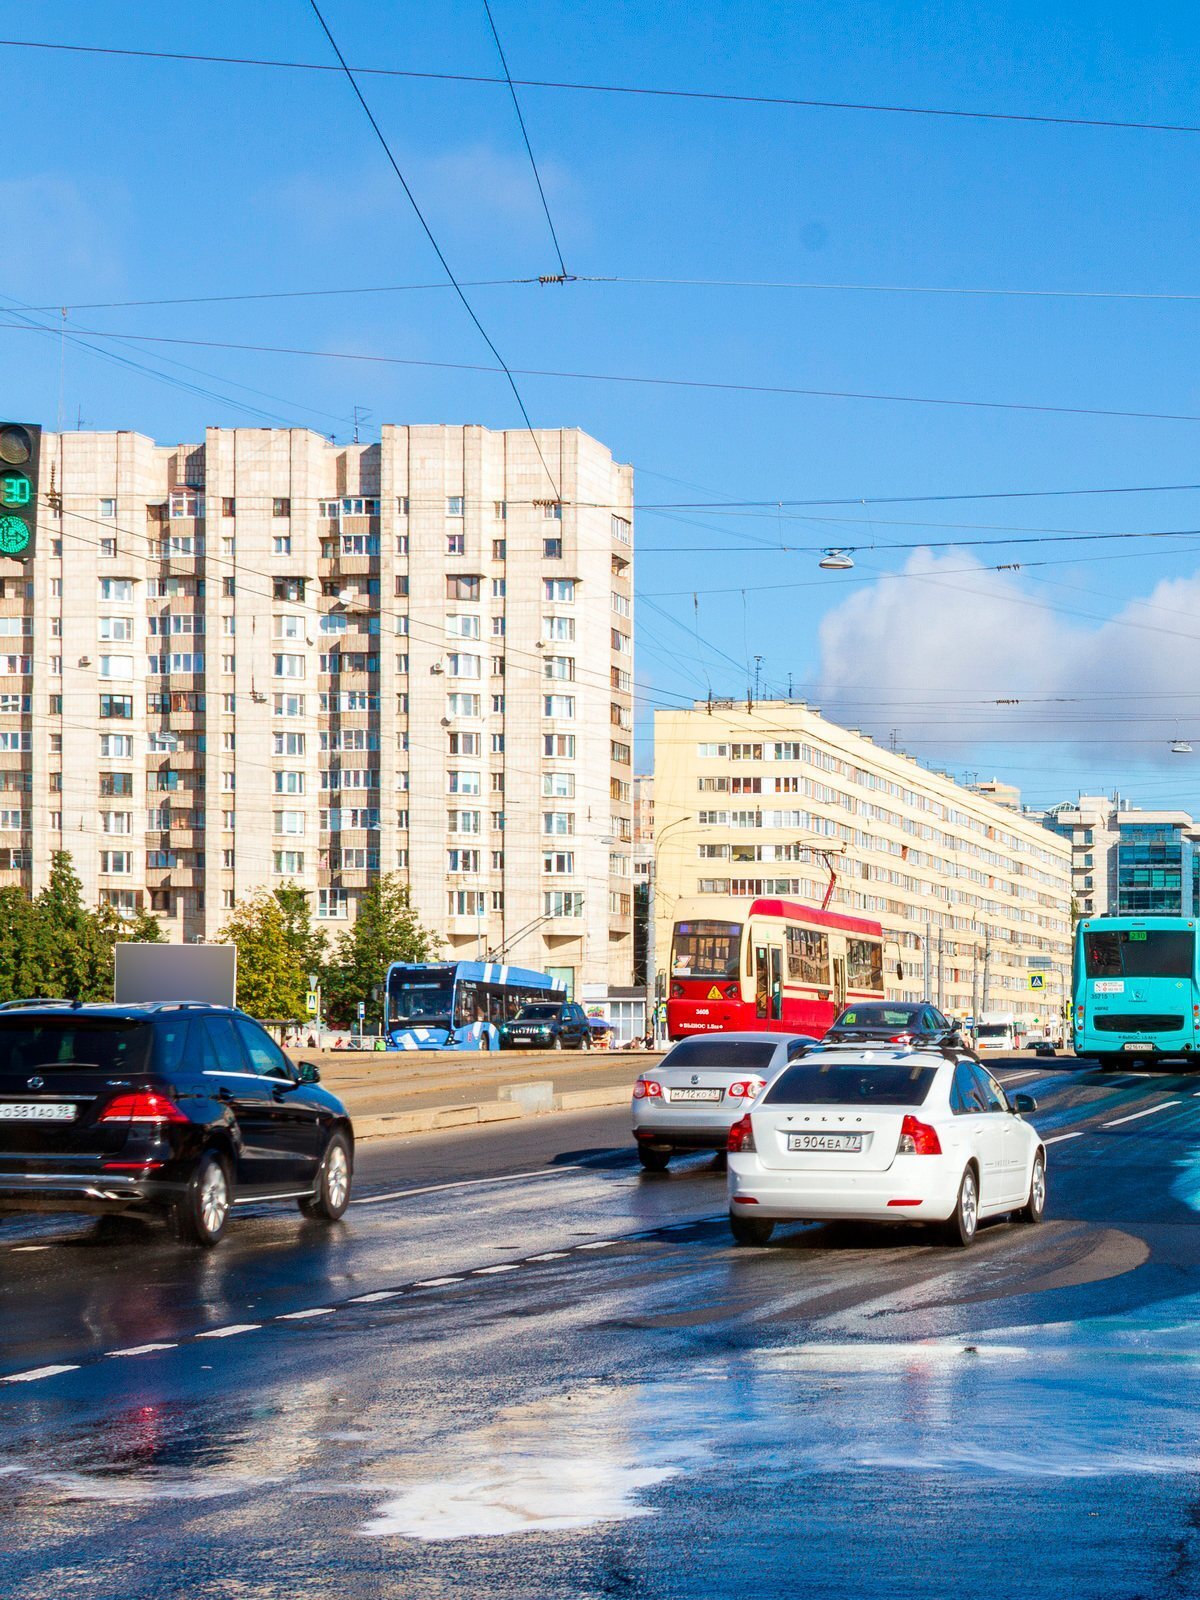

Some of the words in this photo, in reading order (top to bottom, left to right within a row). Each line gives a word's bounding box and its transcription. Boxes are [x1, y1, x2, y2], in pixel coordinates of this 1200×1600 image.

[5, 478, 30, 503] 30
[794, 1136, 841, 1149] В904ЕА
[845, 1136, 858, 1147] 77
